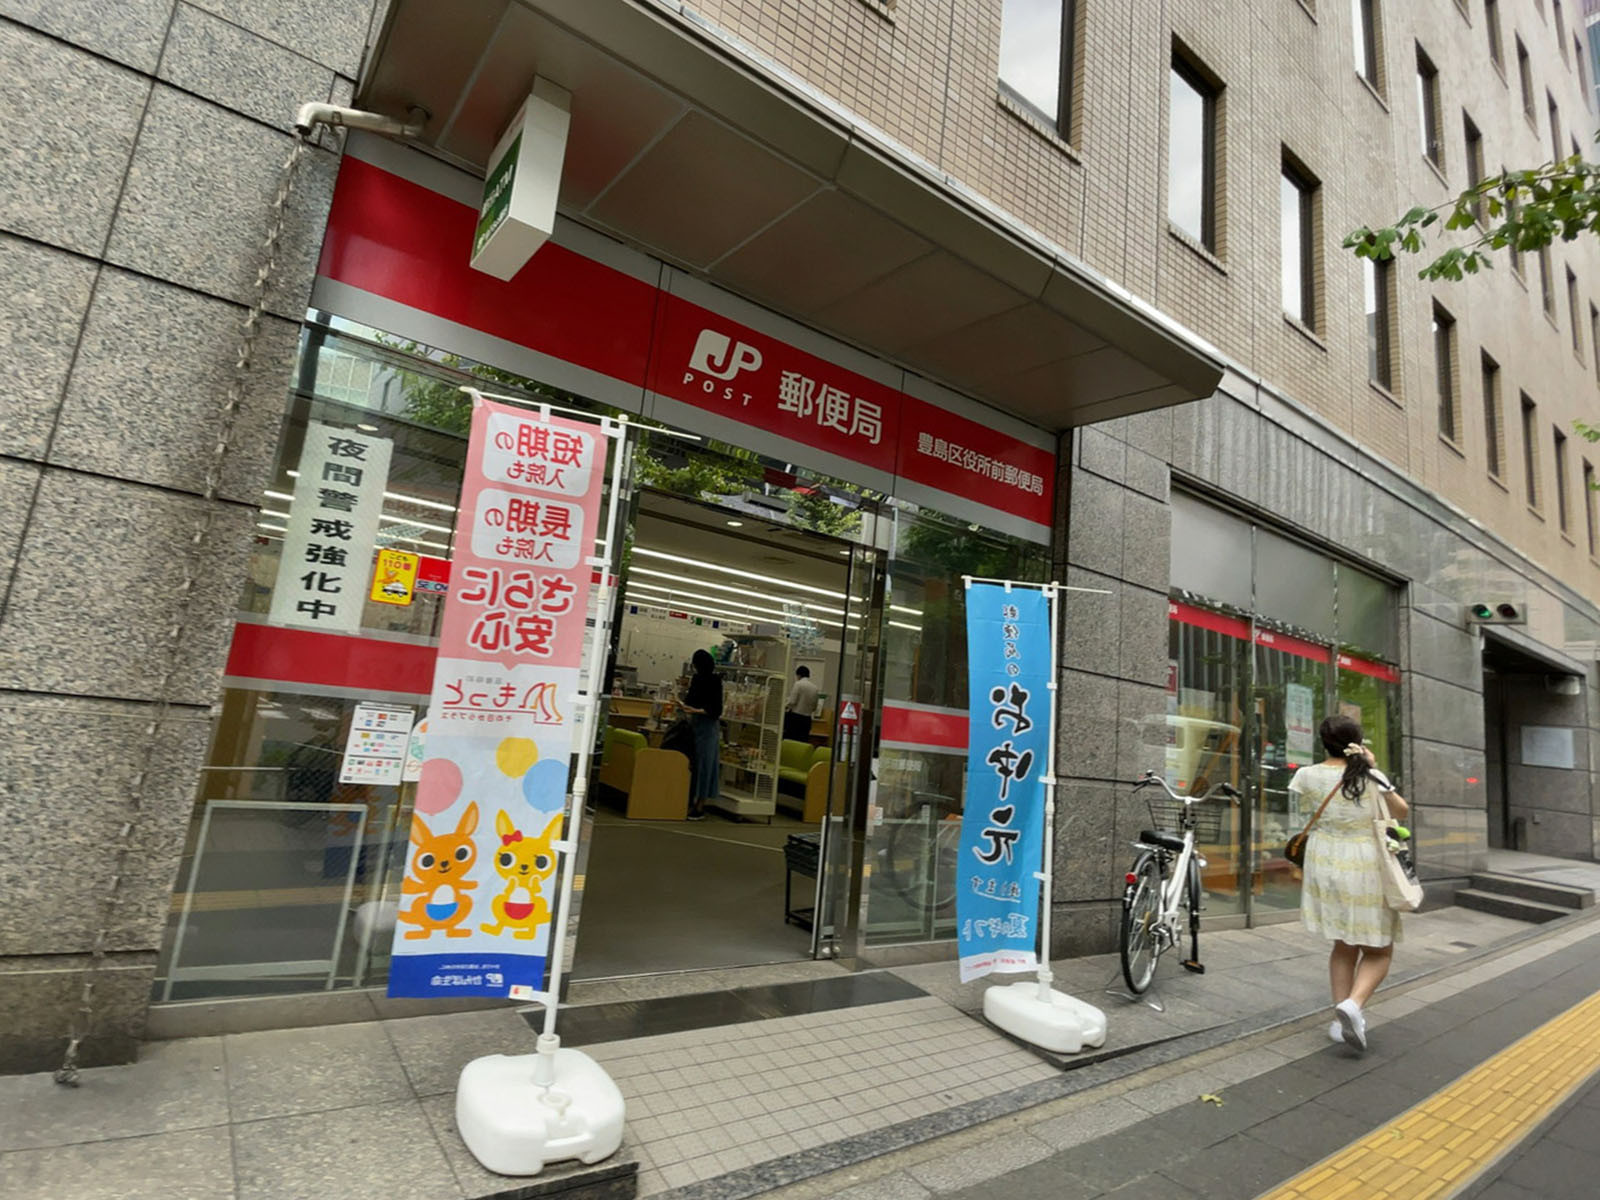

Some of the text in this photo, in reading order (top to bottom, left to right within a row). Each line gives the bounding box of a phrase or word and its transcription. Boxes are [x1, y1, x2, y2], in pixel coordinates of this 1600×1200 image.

[688, 329, 763, 381] JP
[683, 372, 753, 407] POST
[777, 369, 883, 445] 郵便局
[917, 431, 1044, 497] 豊島区役所前郵便局
[296, 436, 369, 620] 夜間警戒強化中
